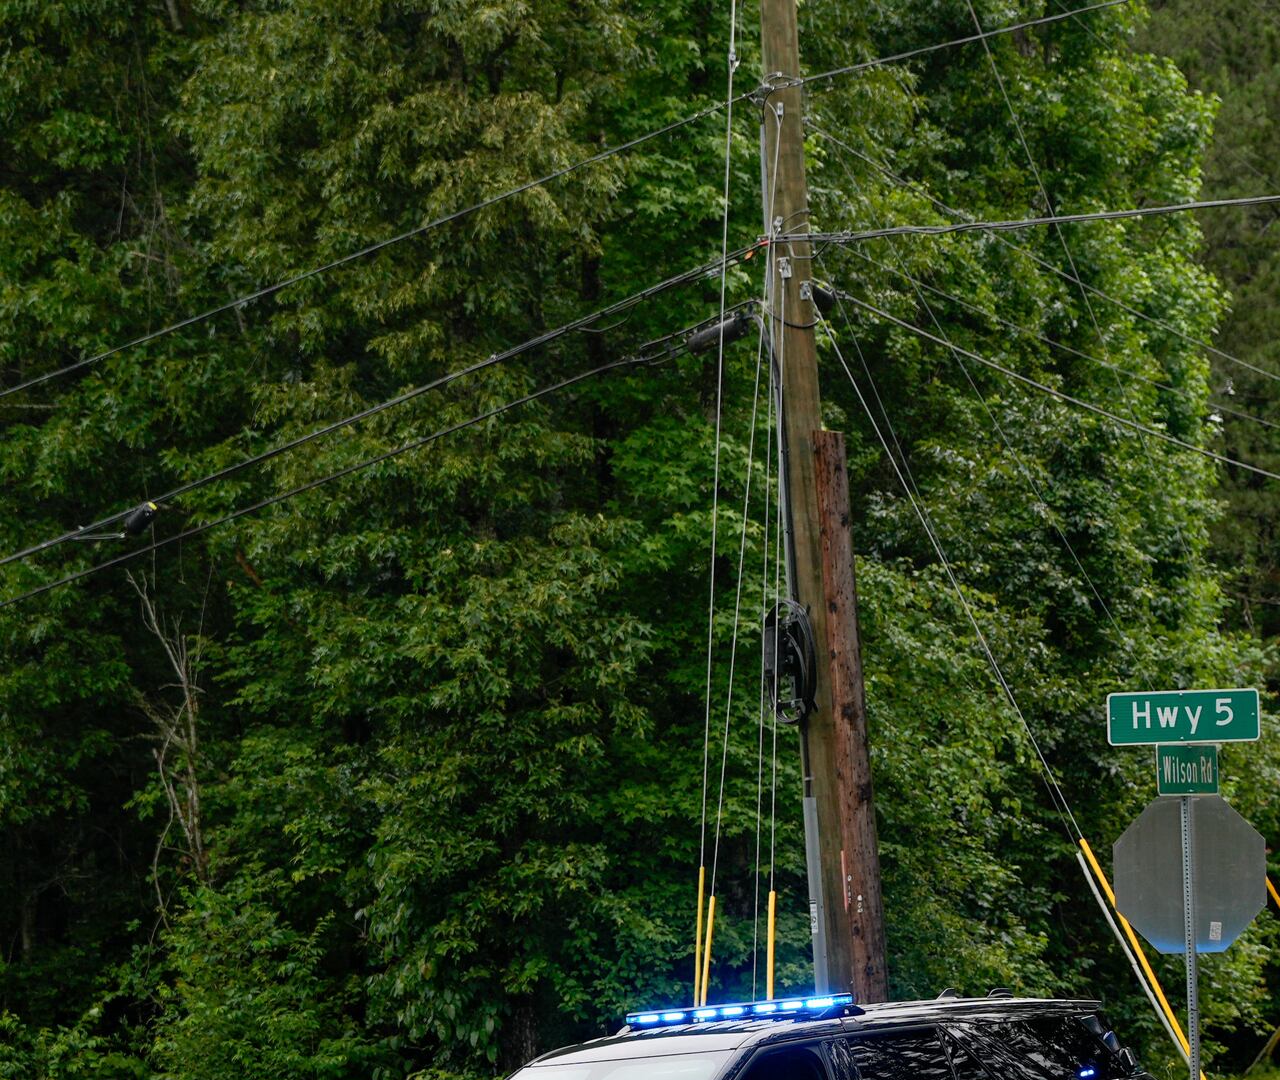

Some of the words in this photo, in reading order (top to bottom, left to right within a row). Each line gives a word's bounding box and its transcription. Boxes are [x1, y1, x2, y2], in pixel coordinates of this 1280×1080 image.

[1131, 700, 1203, 735] Hwy
[1215, 697, 1234, 726] 5
[1162, 755, 1198, 784] Wilson
[1200, 755, 1213, 784] Rd
